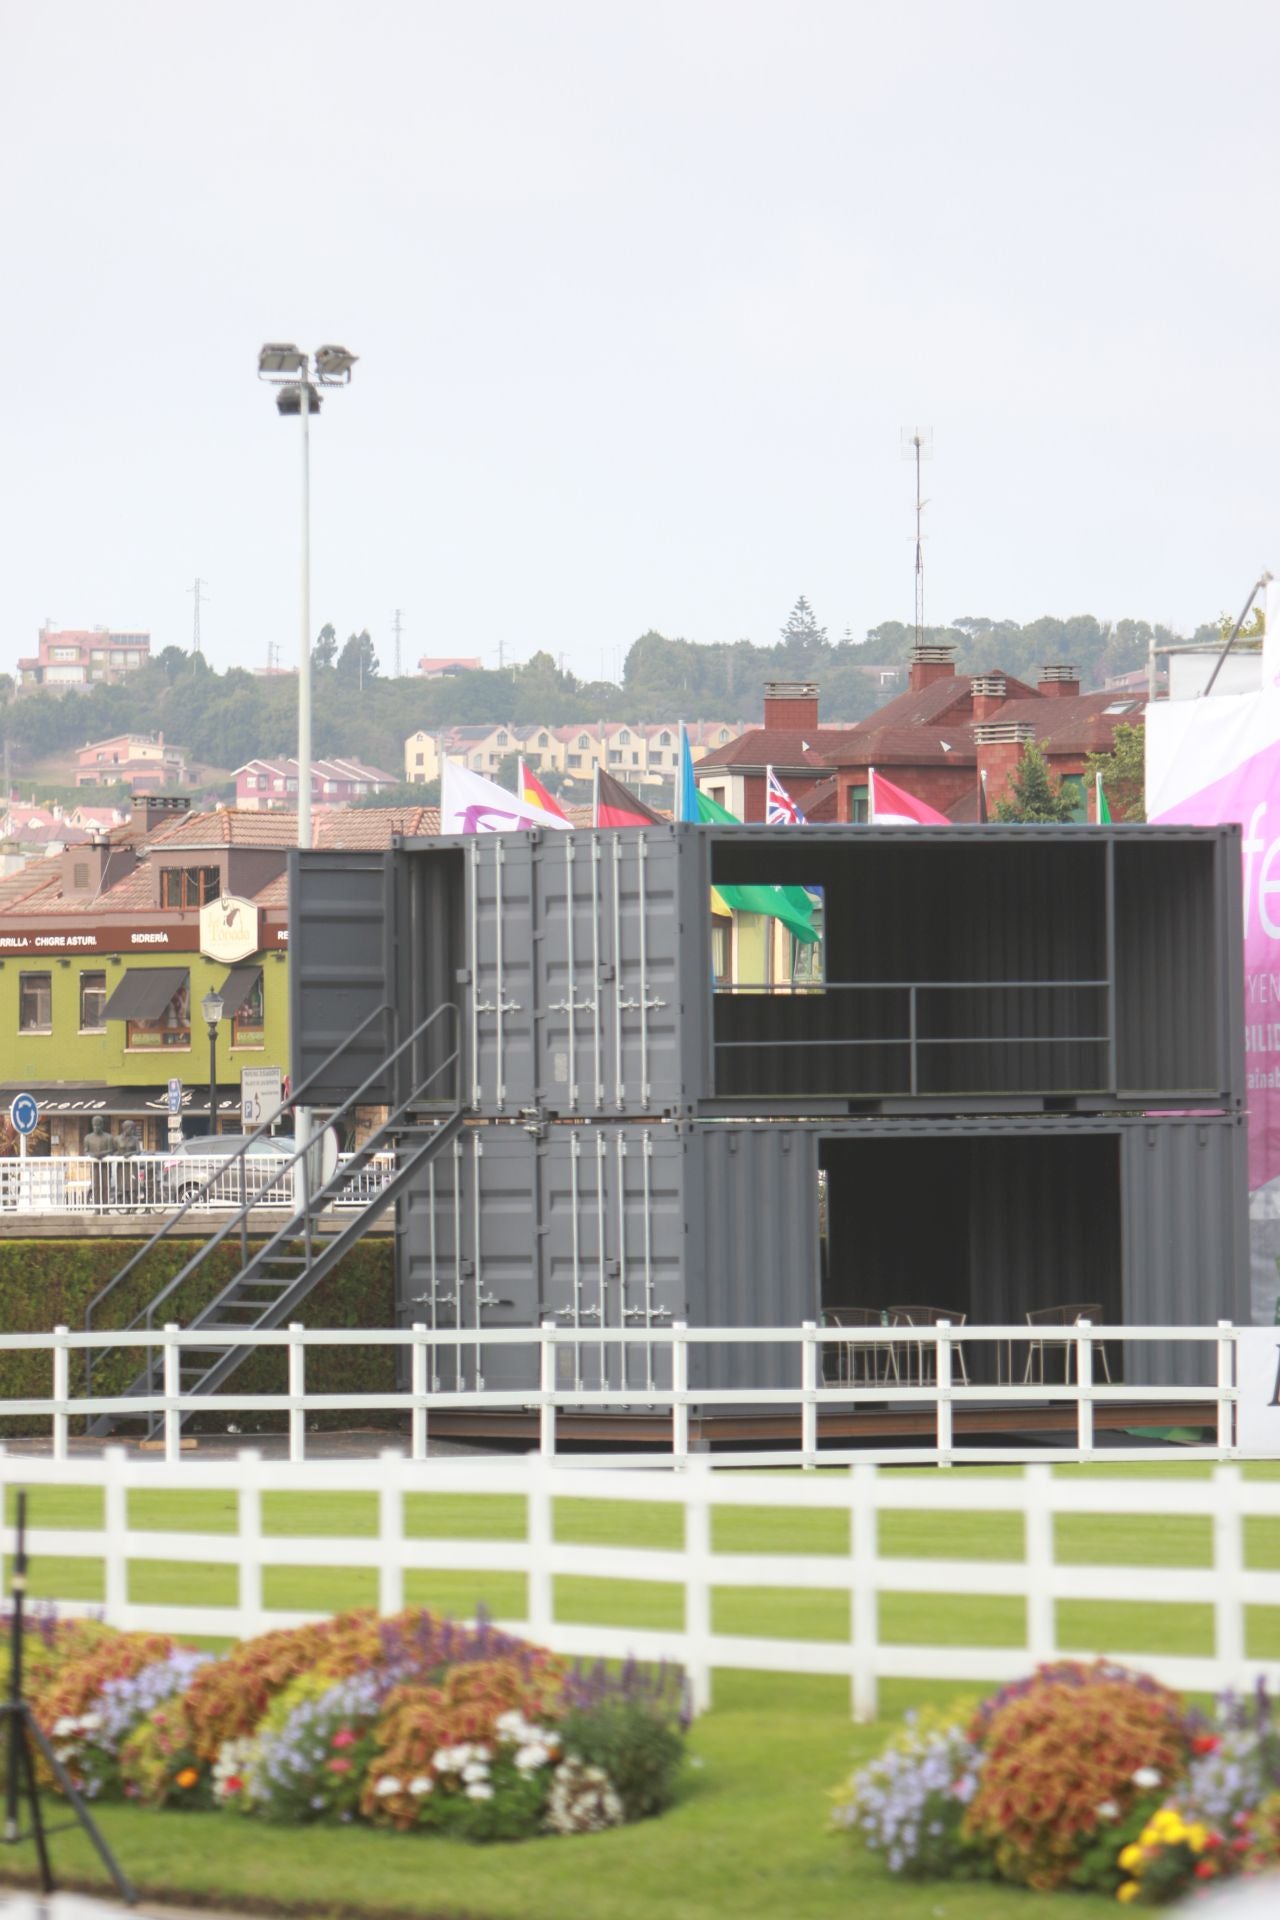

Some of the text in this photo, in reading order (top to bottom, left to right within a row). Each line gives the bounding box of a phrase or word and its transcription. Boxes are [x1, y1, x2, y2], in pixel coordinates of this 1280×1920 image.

[131, 932, 169, 943] SIDRERÍA
[277, 930, 289, 940] RE
[0, 937, 28, 947] RRILLA
[35, 936, 65, 946] CHIGRE
